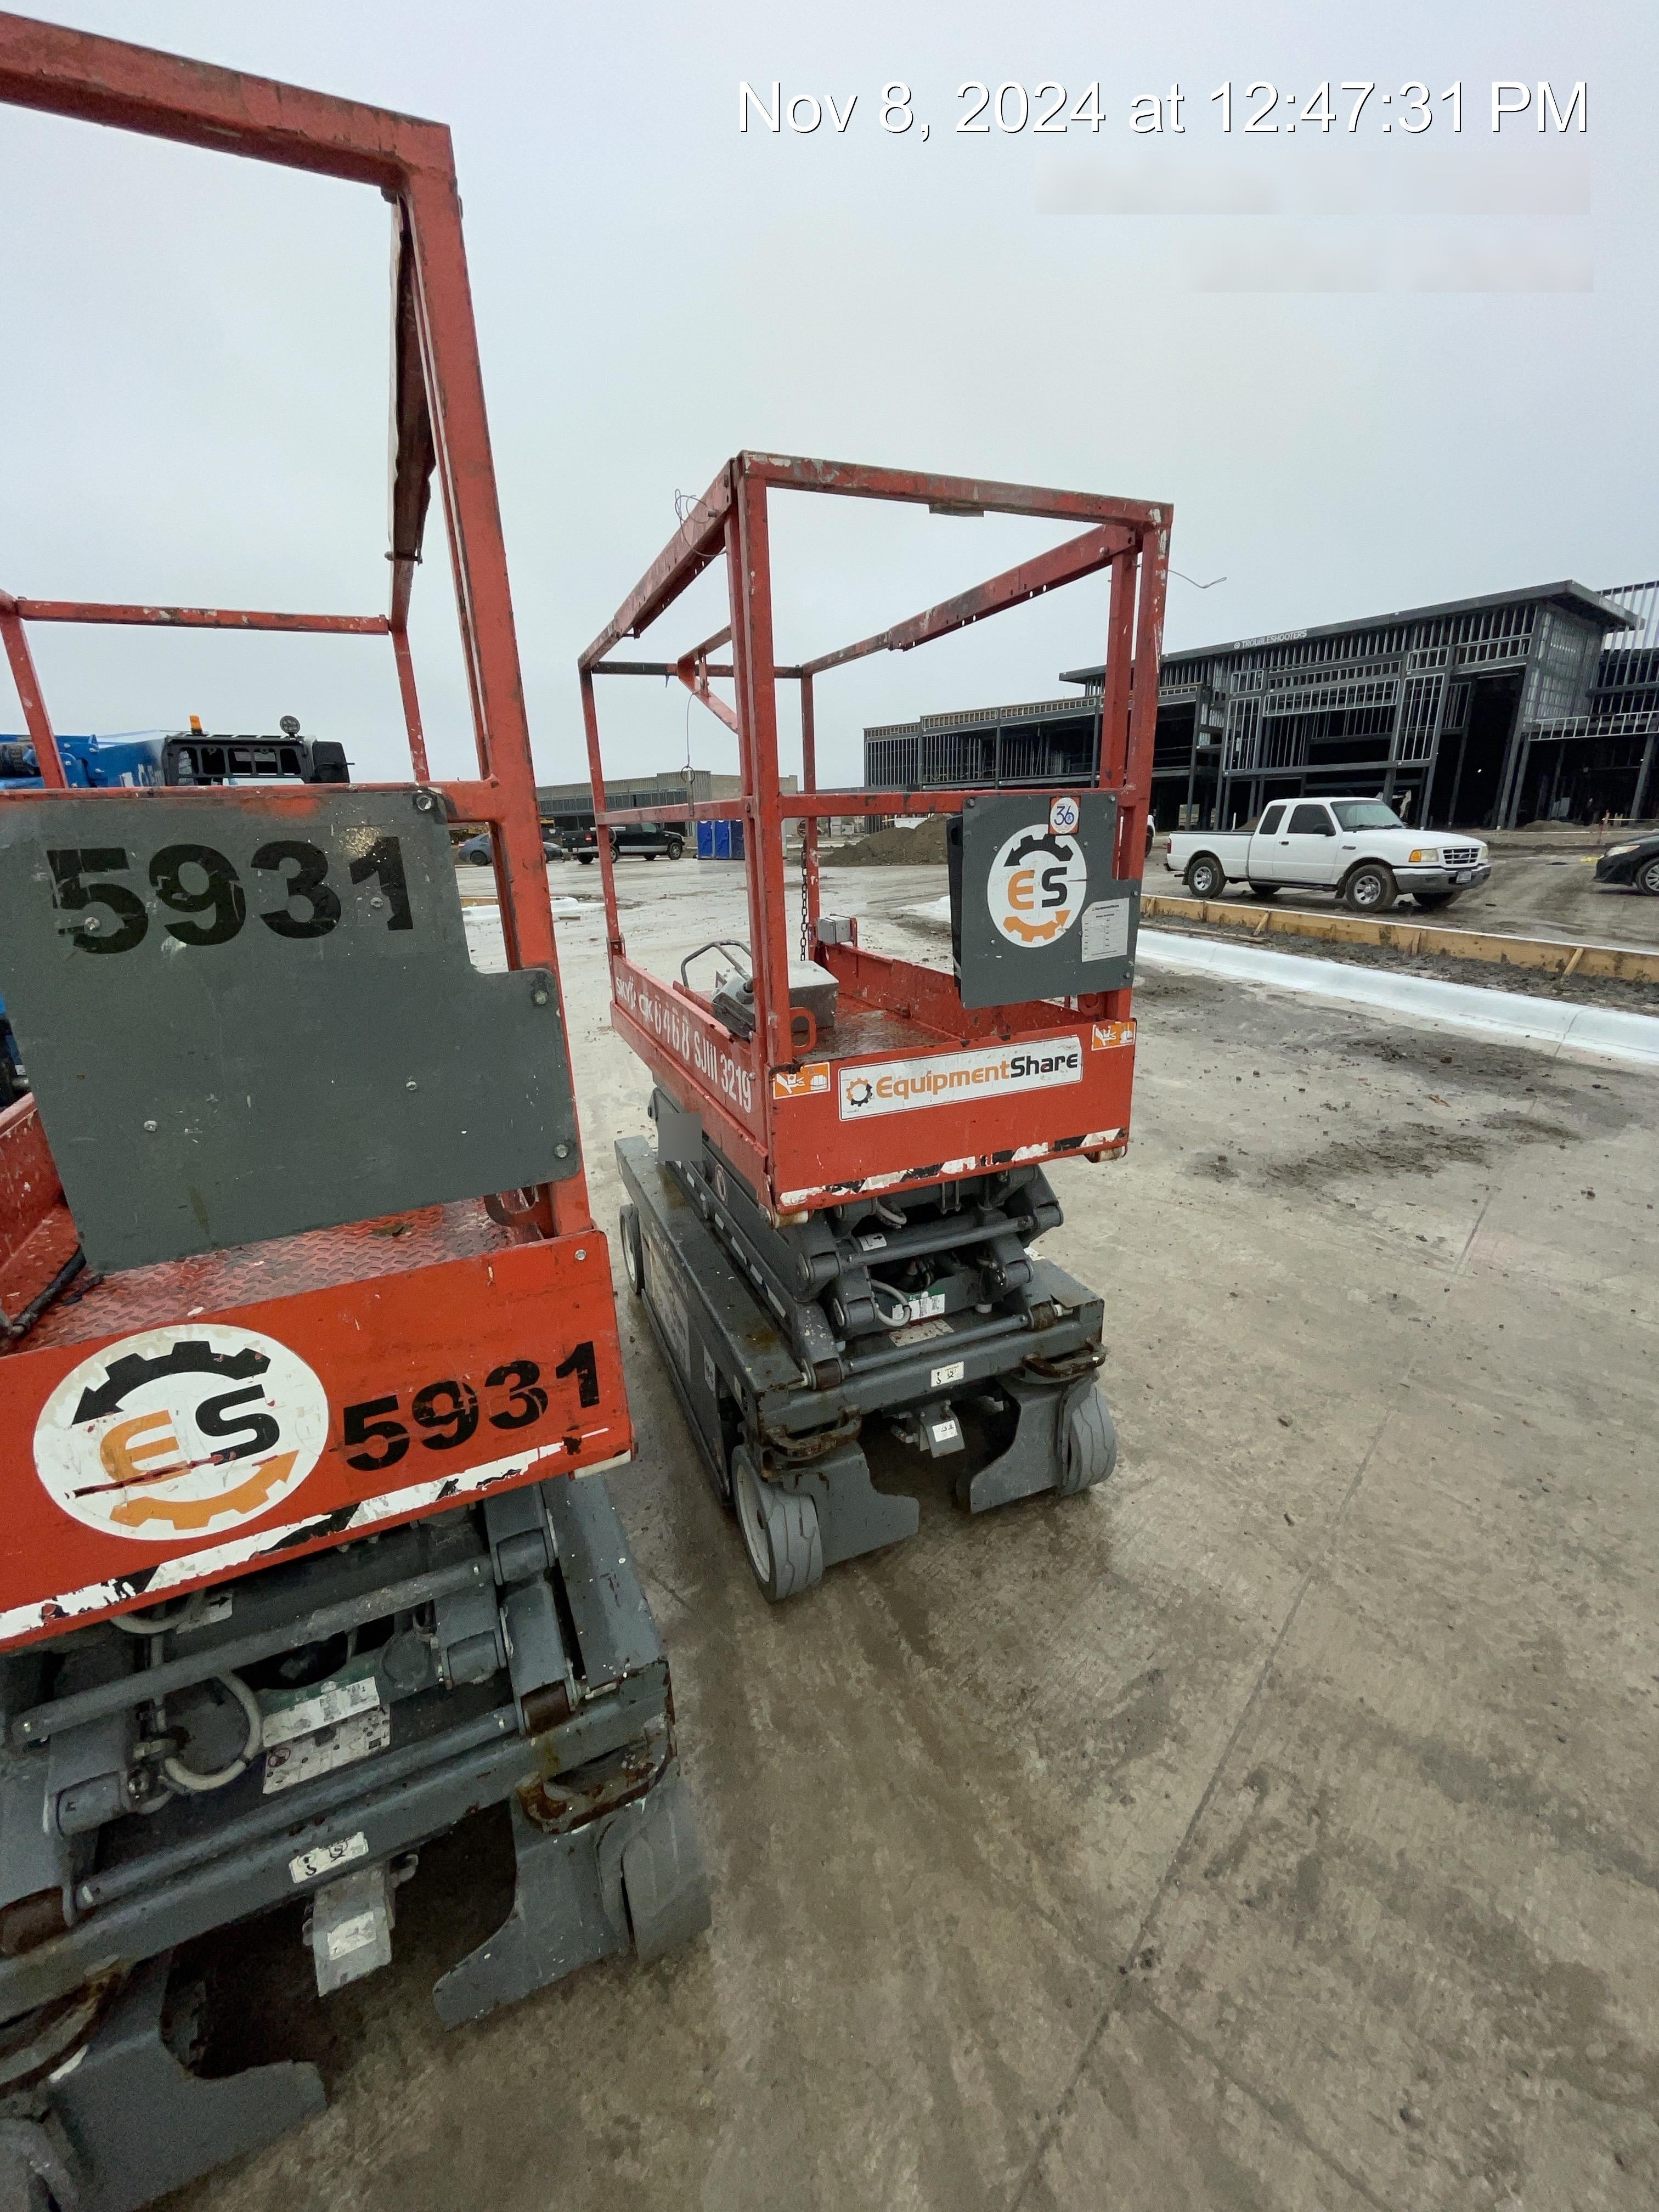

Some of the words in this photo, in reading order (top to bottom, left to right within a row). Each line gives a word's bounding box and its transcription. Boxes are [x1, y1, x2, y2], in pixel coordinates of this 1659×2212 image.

[1242, 630, 1307, 648] TROUBLESHOOTERS
[1054, 805, 1074, 826] 36
[46, 835, 415, 955] 5931
[1007, 866, 1068, 911] ES
[720, 1053, 752, 1114] 3219
[876, 1053, 1079, 1101] EquipmentShare
[100, 1384, 281, 1485] ES
[342, 1341, 601, 1471] 5931
